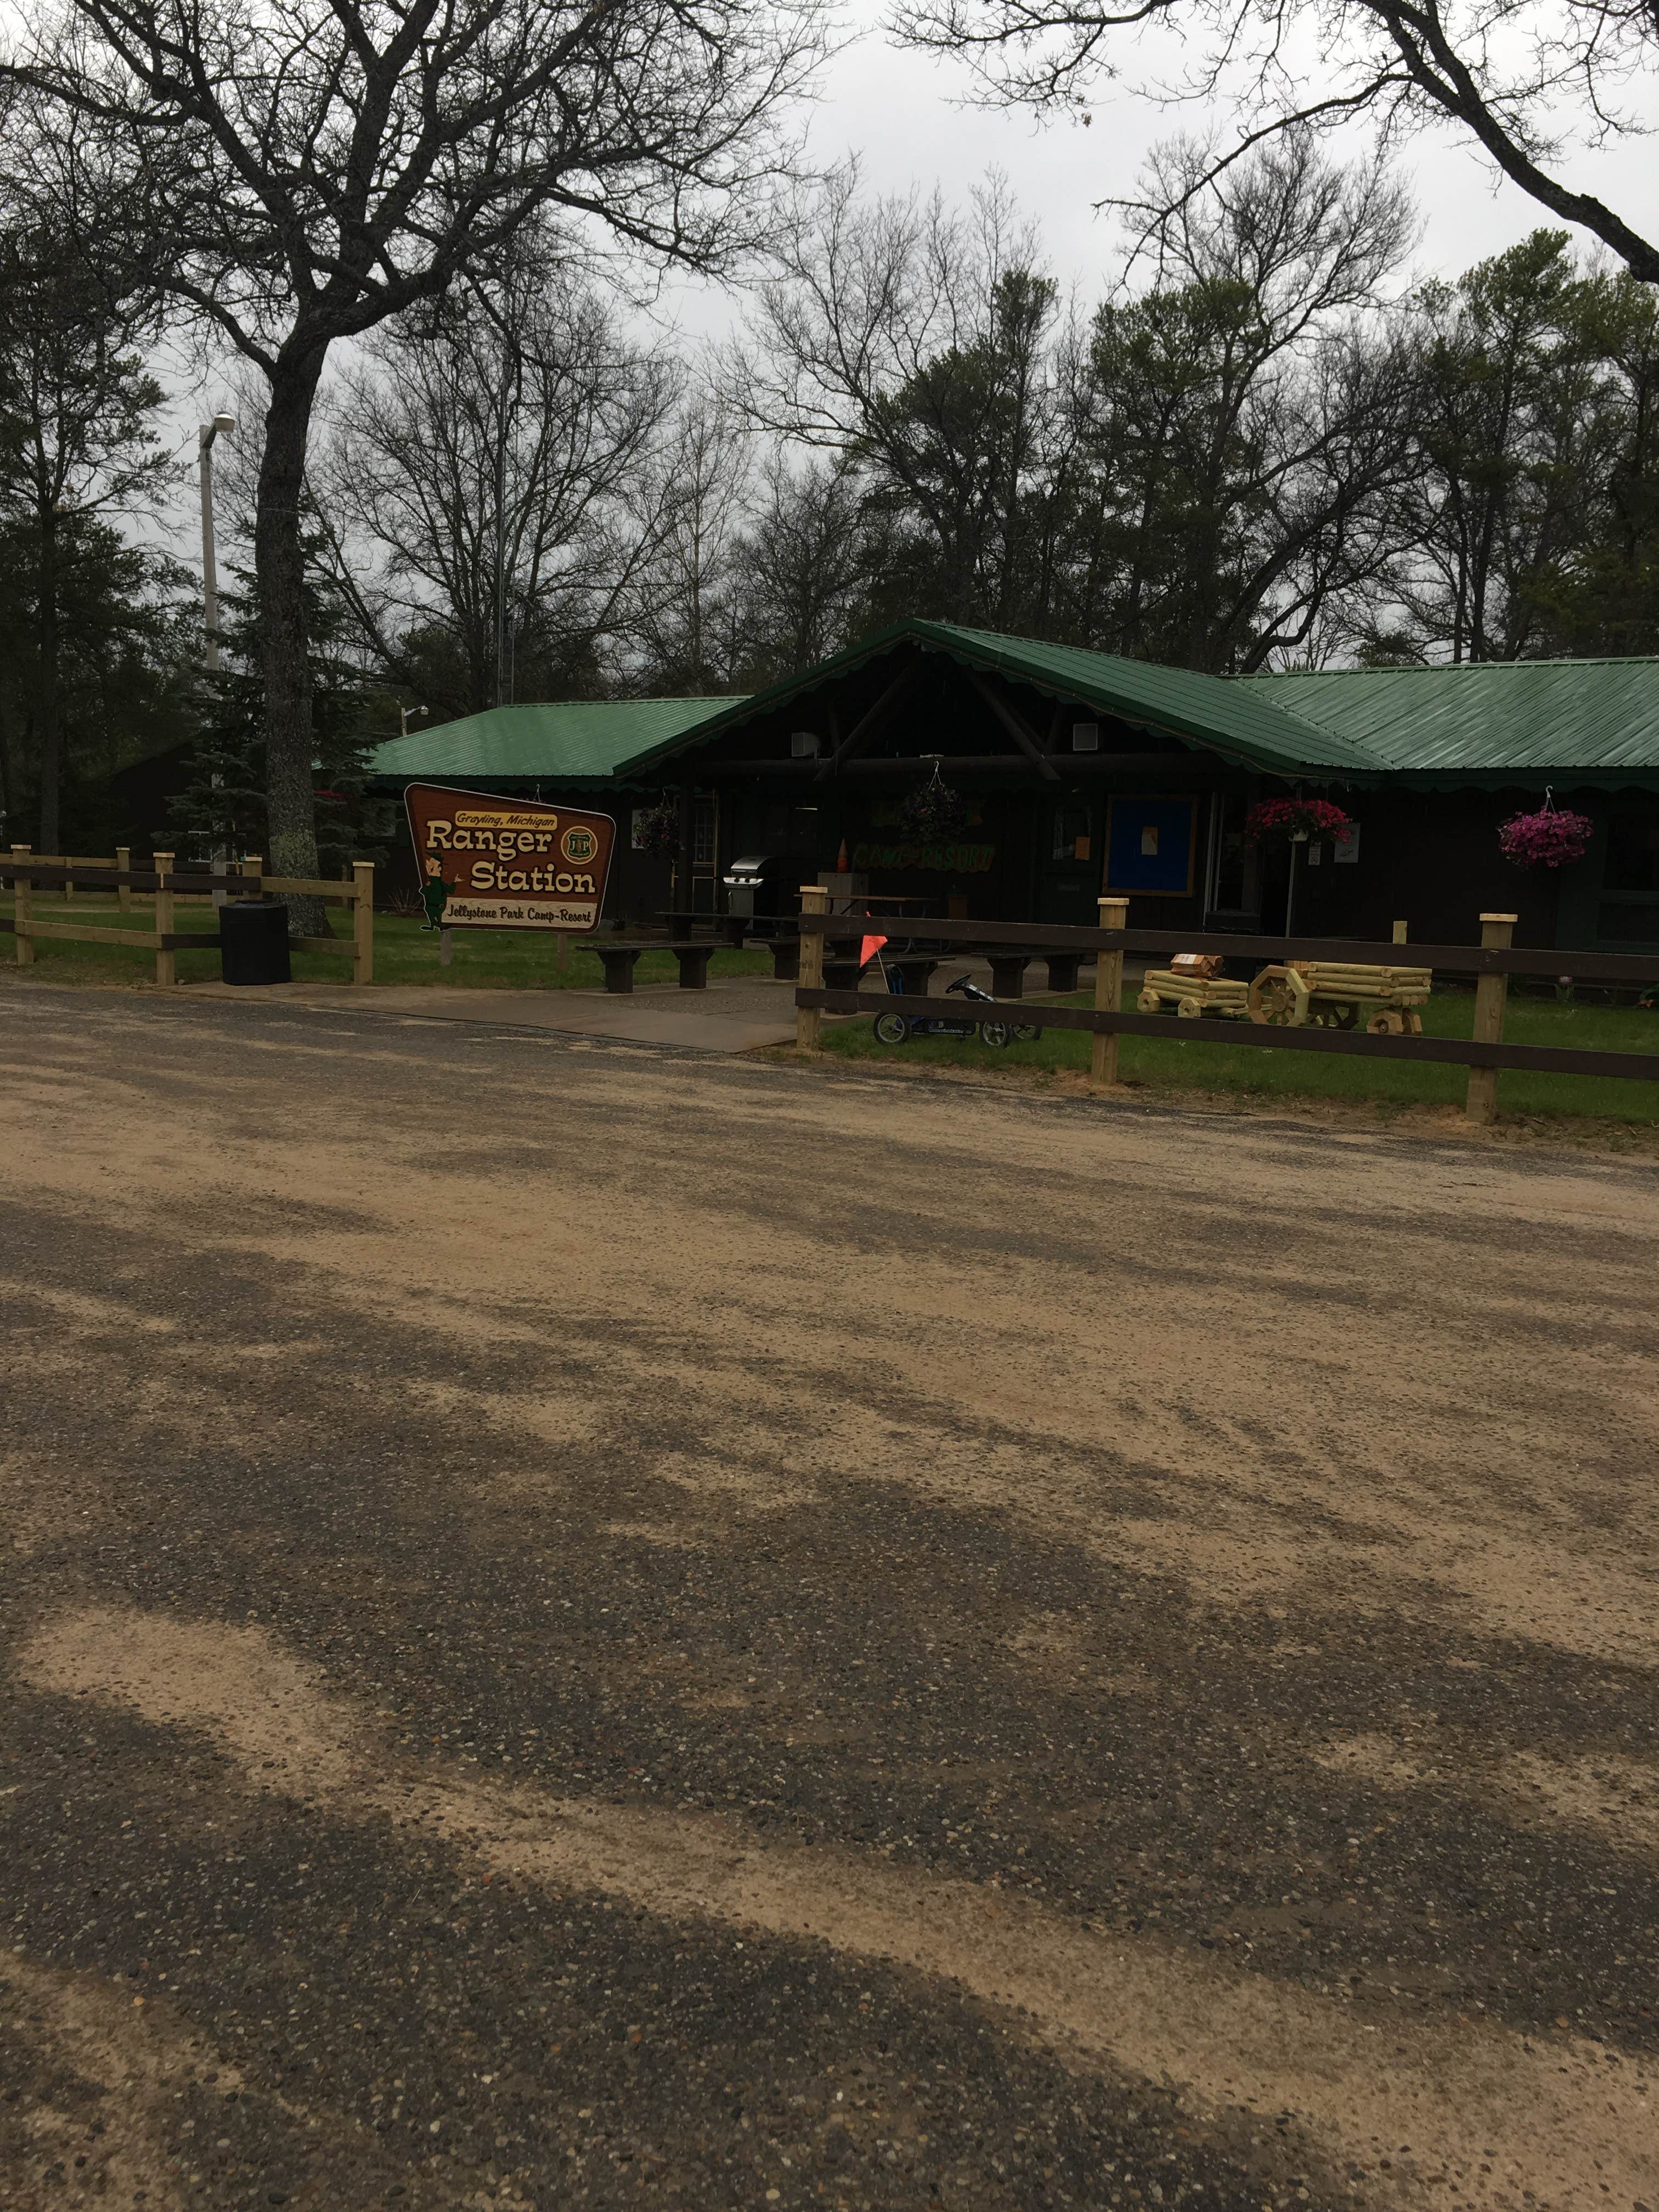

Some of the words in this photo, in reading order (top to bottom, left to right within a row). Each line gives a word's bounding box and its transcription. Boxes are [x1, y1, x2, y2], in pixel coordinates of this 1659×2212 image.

[456, 813, 503, 826] Grayling,
[506, 815, 555, 828] Michigan
[426, 819, 554, 861] Ranger
[569, 840, 575, 851] J
[583, 841, 589, 851] P
[470, 860, 596, 894] Station
[447, 904, 496, 921] Jellystone
[499, 906, 524, 919] Park
[527, 907, 591, 922] Camp-Resort
